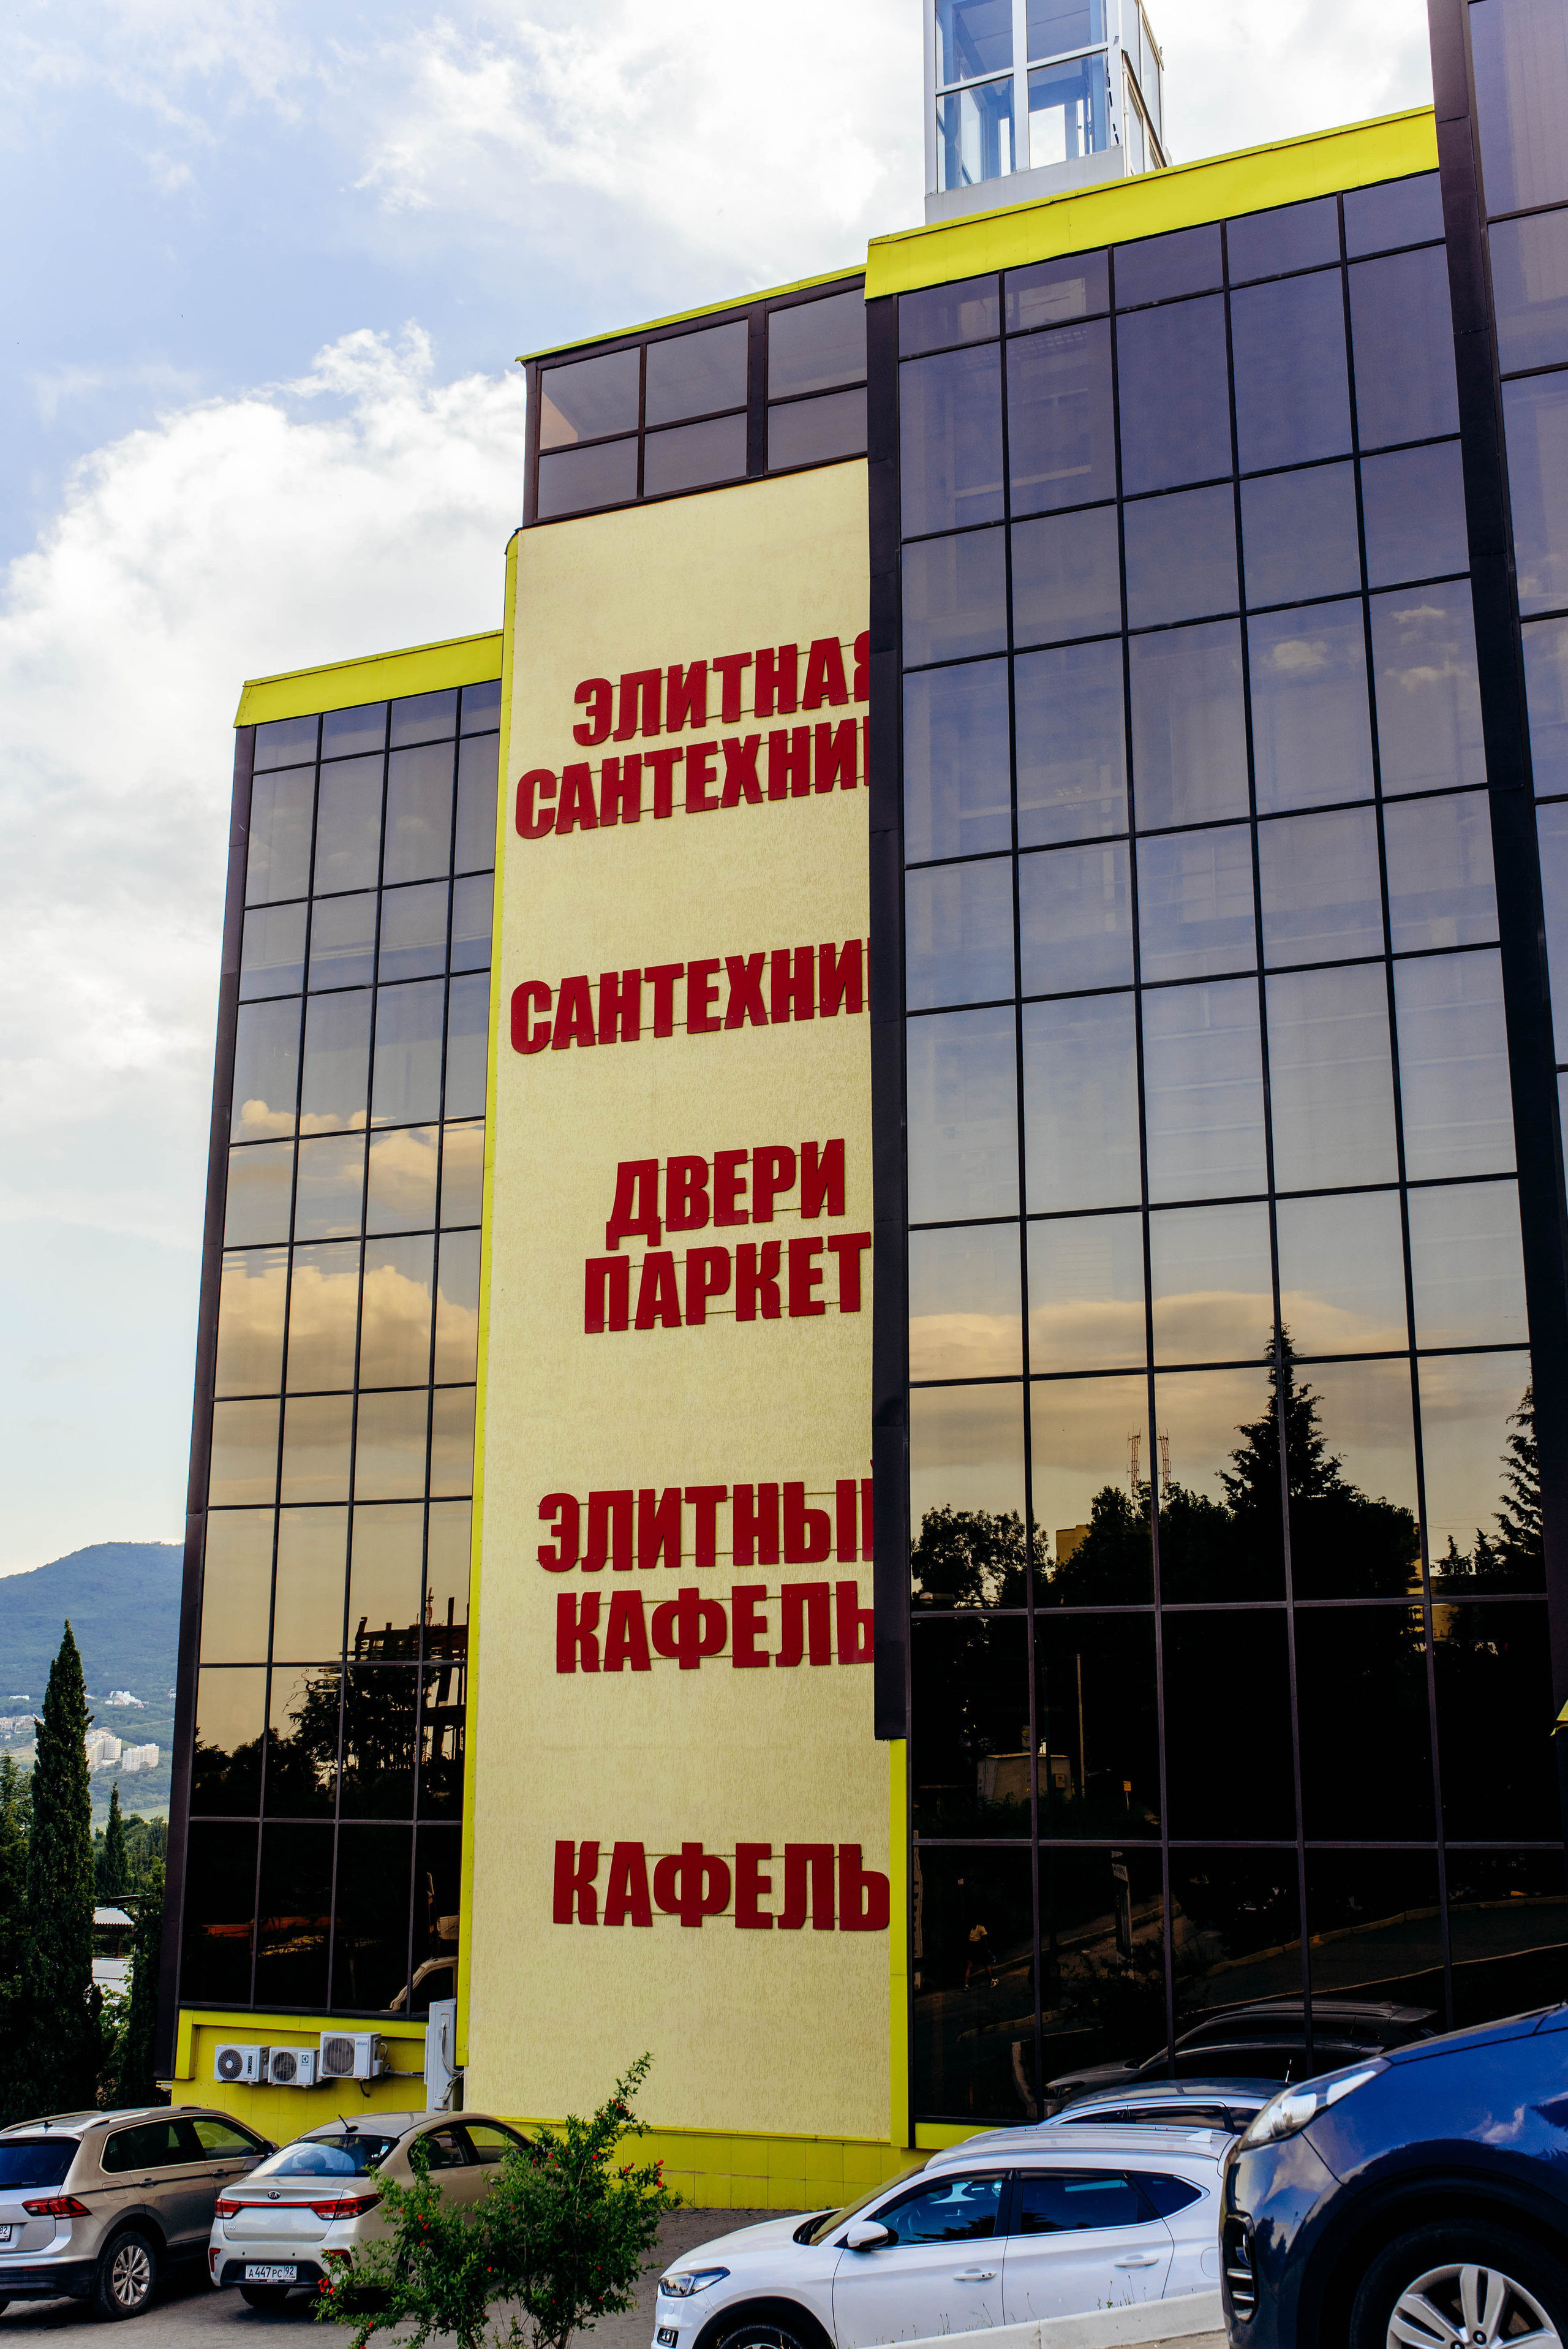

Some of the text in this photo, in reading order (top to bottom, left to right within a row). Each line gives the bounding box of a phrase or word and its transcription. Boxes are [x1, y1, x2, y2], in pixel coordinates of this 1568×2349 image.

[516, 716, 870, 839] САНТЕХНИ
[511, 938, 870, 1054] САНТЕХНИ
[606, 1139, 845, 1250] ДВЕРИ
[585, 1232, 871, 1334] ПАРКЕТ
[538, 1460, 873, 1572] ЭЛИТНЫ
[557, 1581, 874, 1673] КАФЕЛЬ
[553, 1840, 889, 1931] КАФЕЛЬ
[285, 2266, 294, 2275] 92
